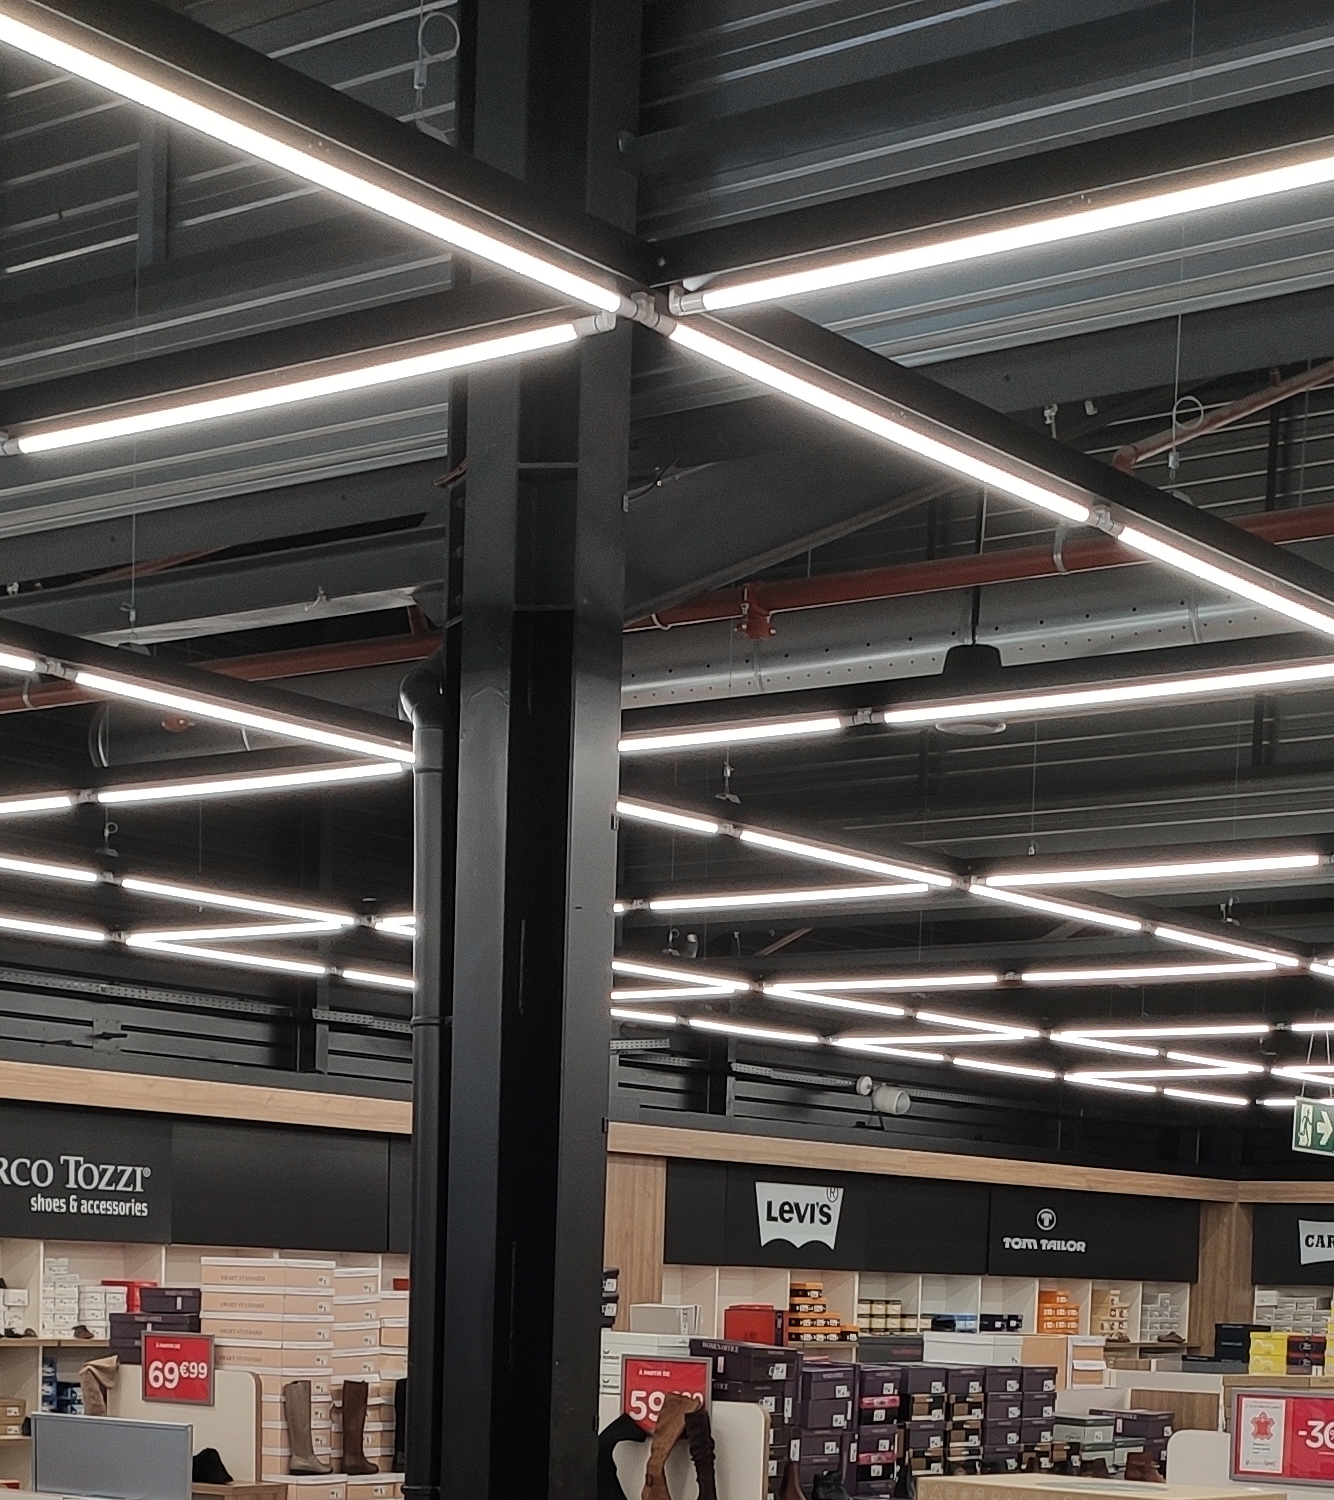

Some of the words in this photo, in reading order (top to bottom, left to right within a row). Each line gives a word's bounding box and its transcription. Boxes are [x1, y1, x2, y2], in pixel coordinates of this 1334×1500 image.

[30, 1193, 67, 1213] shoes
[69, 1194, 78, 1213] &
[80, 1198, 148, 1217] accessories
[1003, 1236, 1038, 1251] TOM
[1039, 1238, 1087, 1254] TAILOR
[148, 1361, 208, 1389] 69€99
